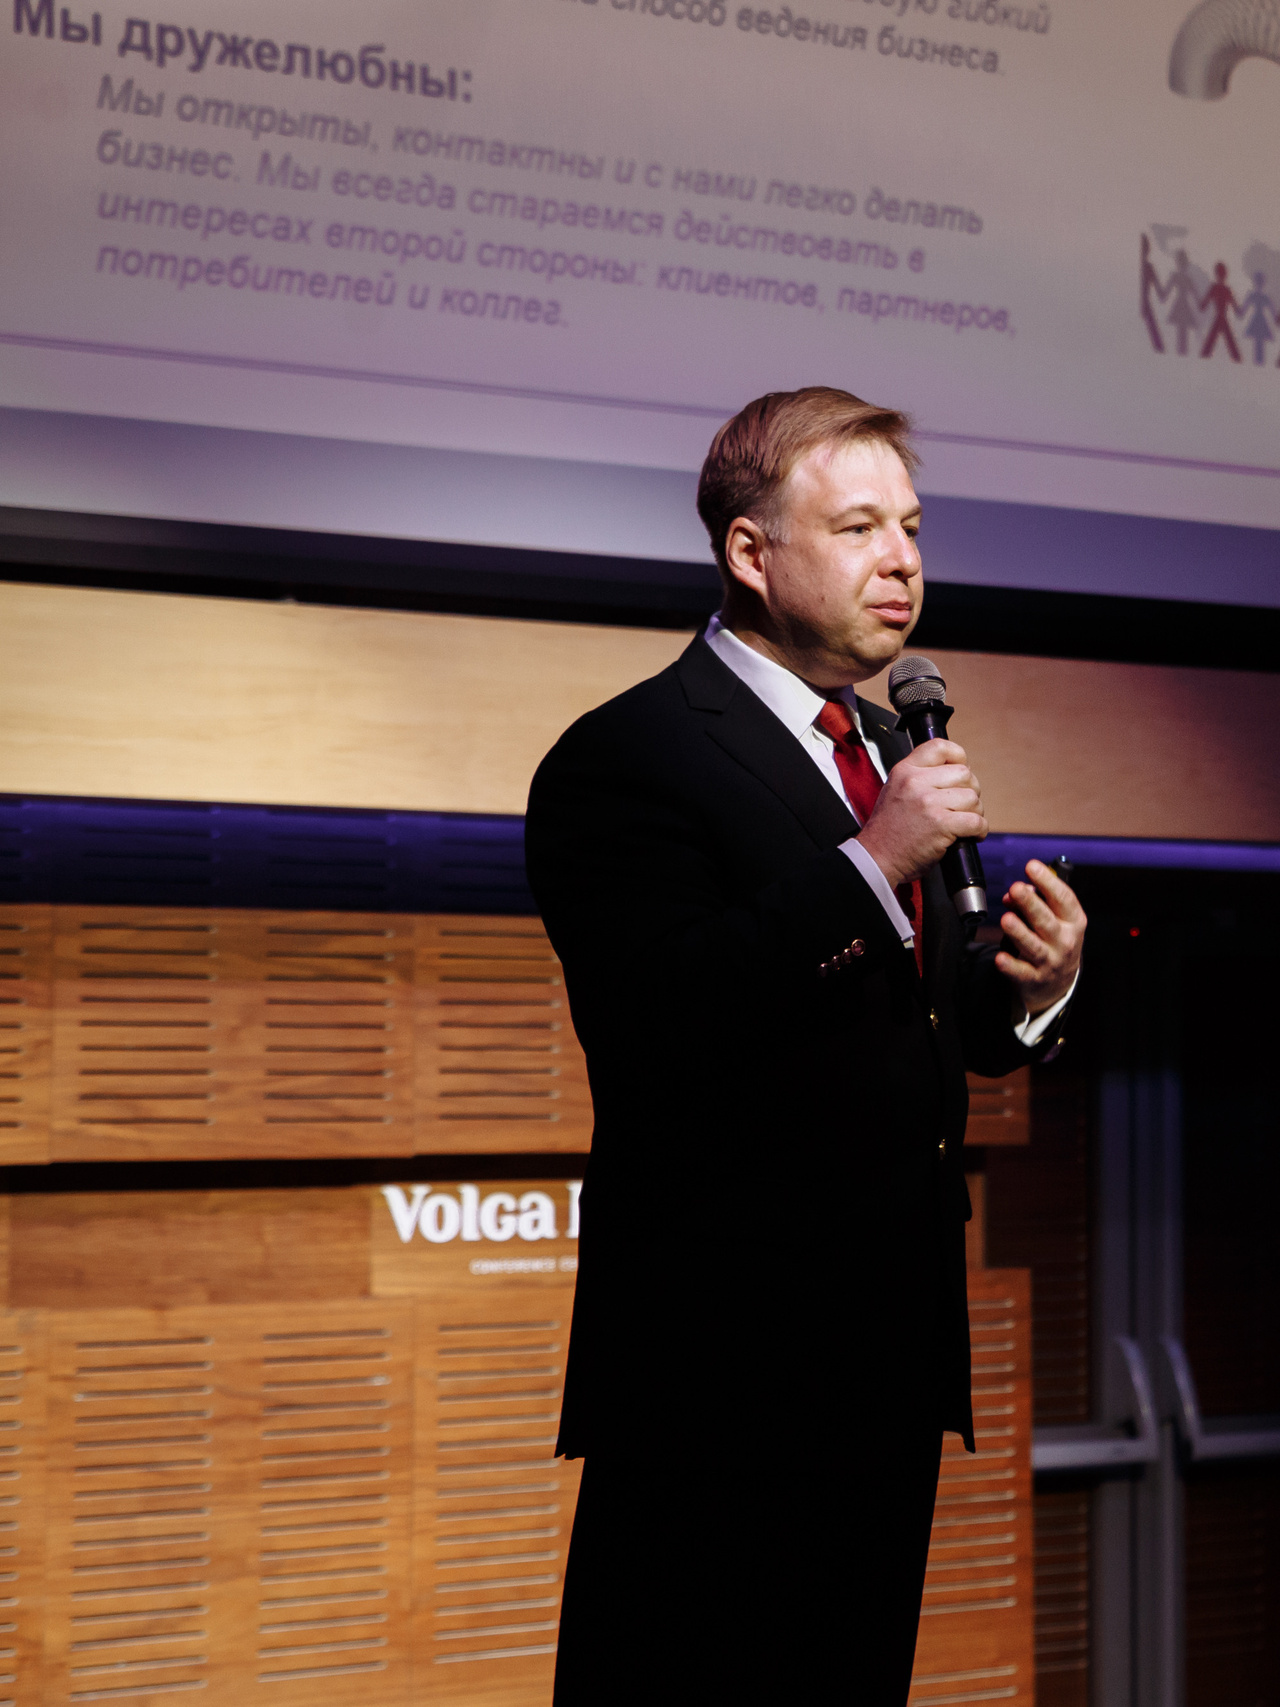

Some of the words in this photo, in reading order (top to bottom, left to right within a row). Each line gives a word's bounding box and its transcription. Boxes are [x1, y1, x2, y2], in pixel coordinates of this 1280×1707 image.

[13, 0, 102, 46] Мы
[117, 17, 473, 102] дружелюбны:
[736, 6, 867, 50] ведения
[96, 130, 241, 183] бизнес.
[256, 152, 320, 191] Мы
[331, 168, 457, 210] всегда
[468, 187, 663, 236] стараемся
[673, 210, 899, 269] действовать
[907, 248, 926, 273] в
[97, 74, 165, 119] Мы
[176, 92, 380, 152] открыты,
[392, 125, 603, 181] контактны
[614, 160, 636, 184] и
[643, 163, 662, 189] с
[671, 168, 758, 202] нами
[765, 178, 856, 217] легко
[863, 187, 984, 235] делать
[96, 246, 396, 305] потребителей
[408, 282, 429, 310] и
[97, 193, 312, 243] интересах
[325, 222, 467, 263] второй
[656, 264, 825, 313] клиентов,
[836, 286, 1016, 337] партнеров,
